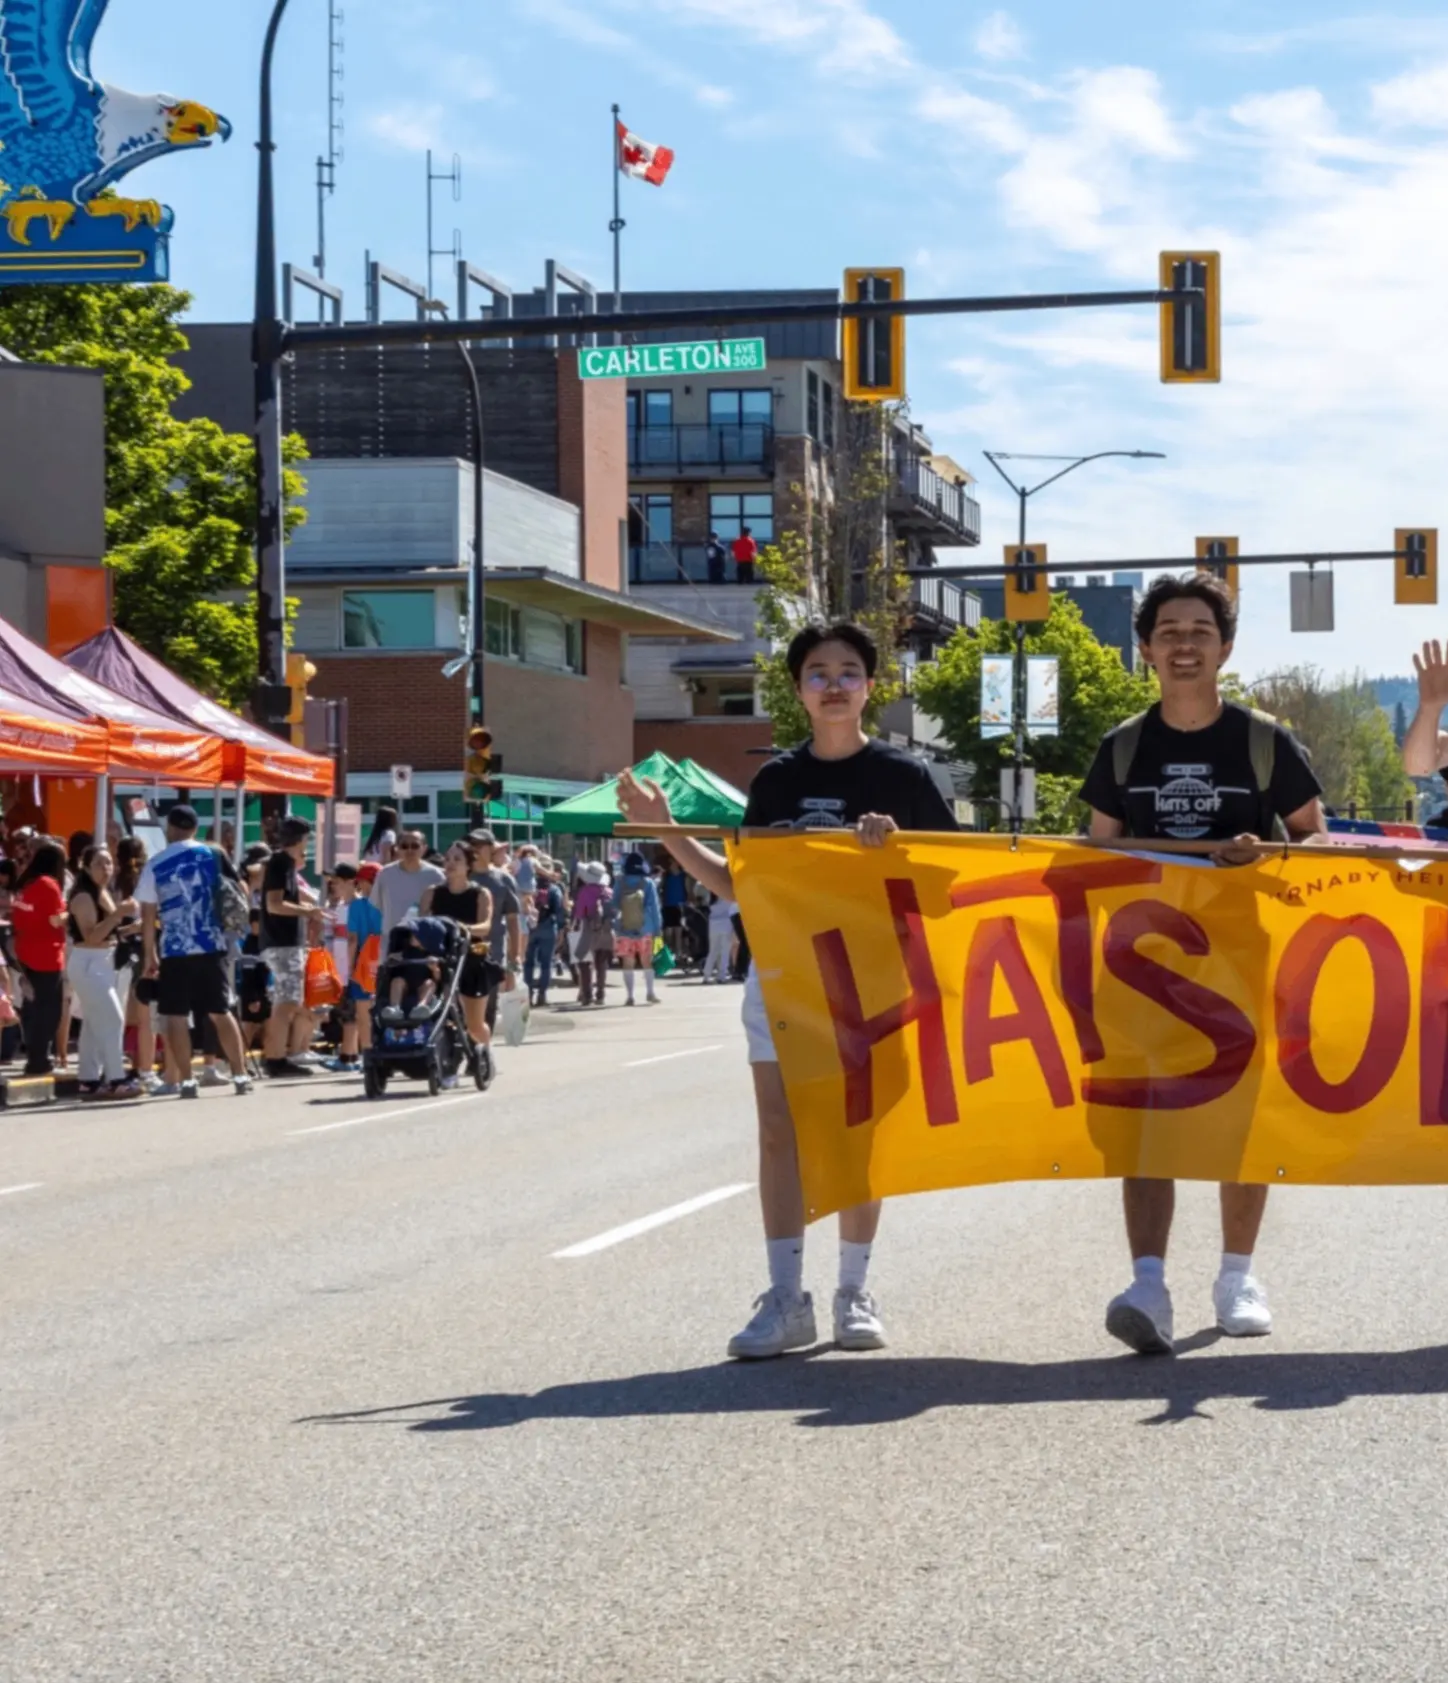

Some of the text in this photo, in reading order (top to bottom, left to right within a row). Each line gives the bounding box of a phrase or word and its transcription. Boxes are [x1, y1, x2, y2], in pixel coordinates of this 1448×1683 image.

[586, 344, 732, 376] CARLETON
[734, 343, 756, 355] AVE
[1155, 797, 1222, 812] HATS OFF
[811, 857, 1257, 1128] HATS
